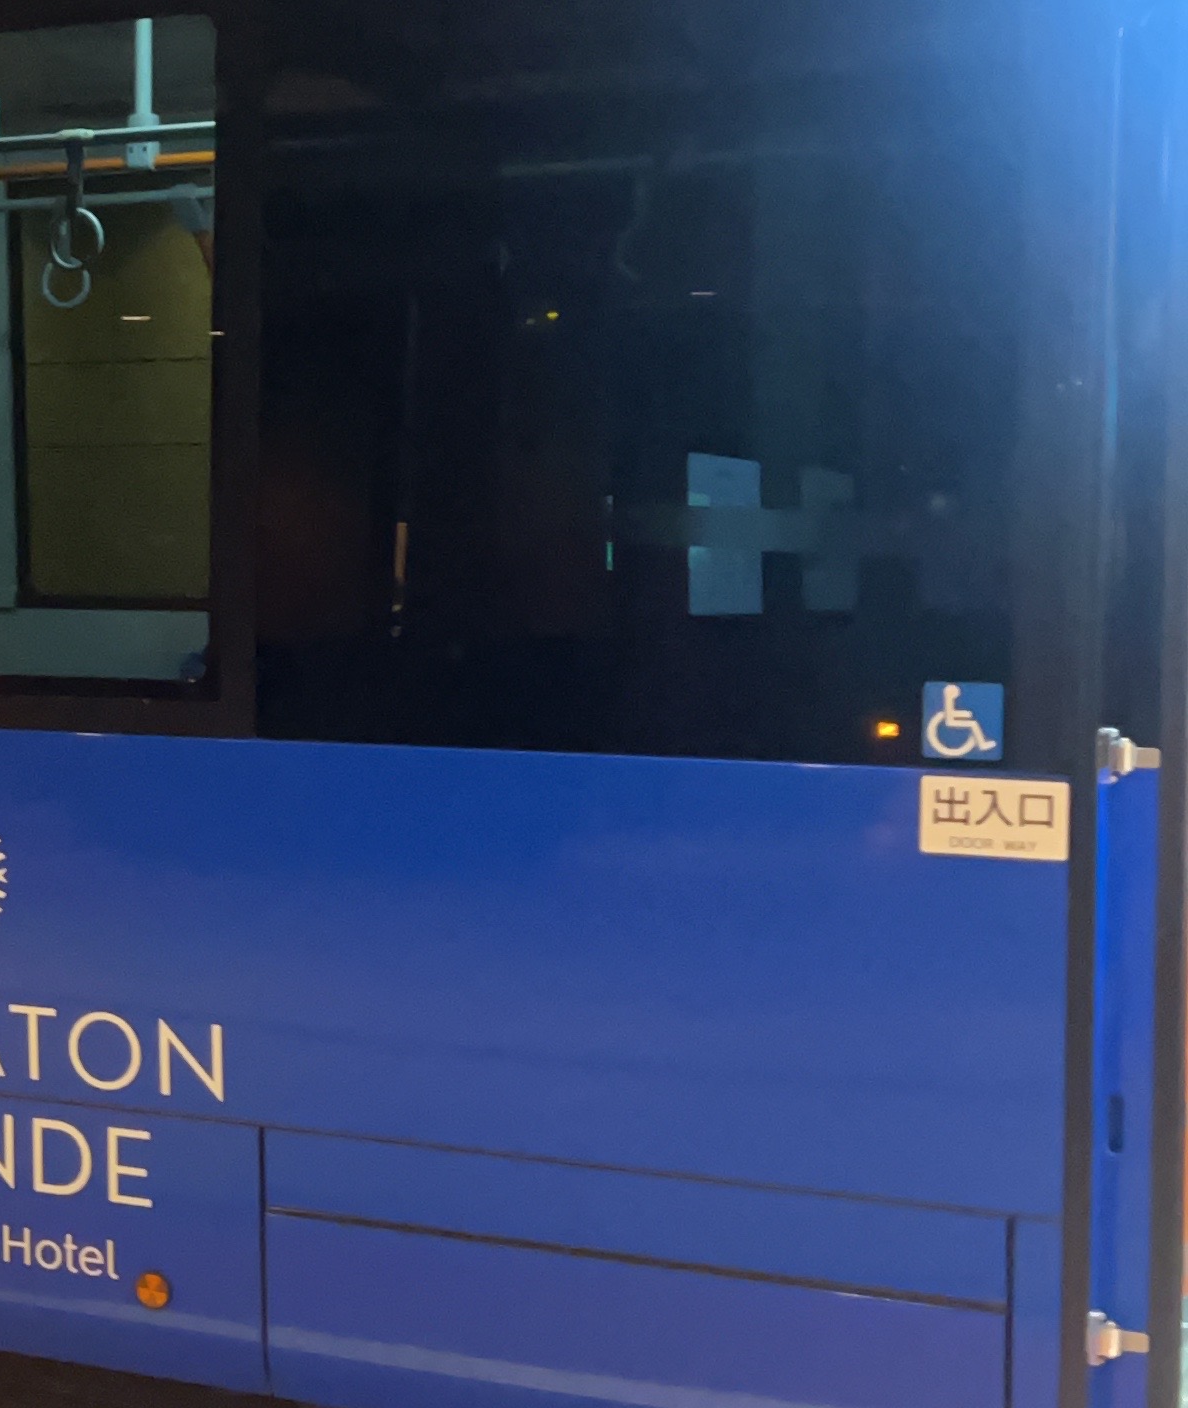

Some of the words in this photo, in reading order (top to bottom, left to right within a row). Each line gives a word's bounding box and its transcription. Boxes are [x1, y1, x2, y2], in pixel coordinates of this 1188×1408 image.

[933, 786, 1054, 828] 出入口
[948, 835, 995, 850] DOOR
[1003, 840, 1038, 852] WAY
[1, 1224, 120, 1280] Hotel
